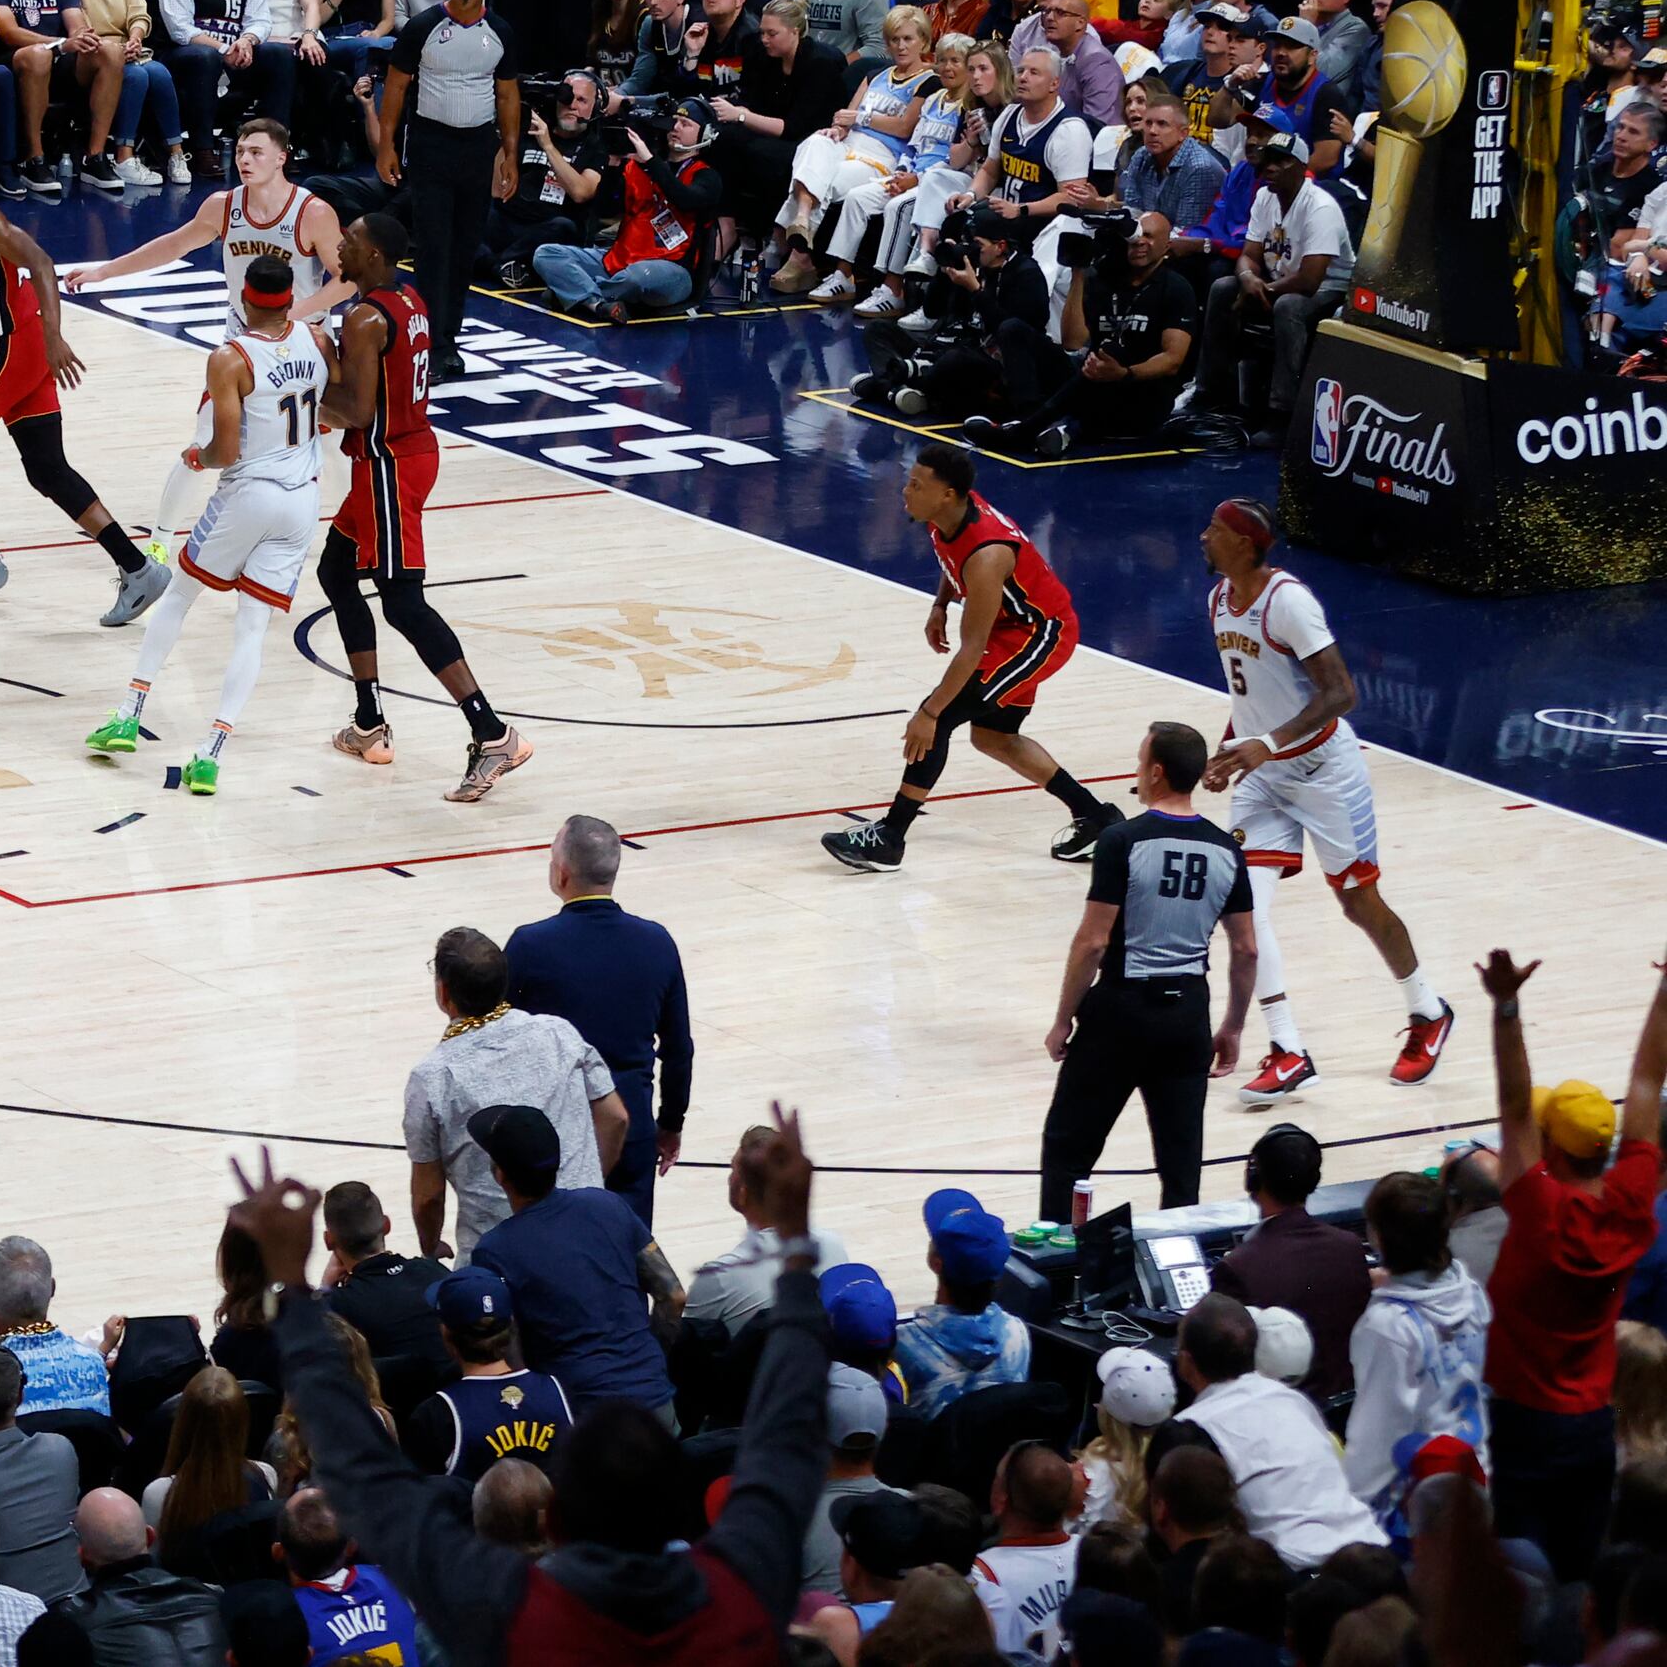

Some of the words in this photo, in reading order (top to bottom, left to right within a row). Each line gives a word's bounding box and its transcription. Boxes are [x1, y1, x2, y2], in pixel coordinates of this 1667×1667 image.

[1474, 115, 1506, 148] GET
[1001, 155, 1040, 185] ENVER
[1474, 150, 1503, 184] THE
[1471, 185, 1503, 219] APP
[280, 224, 295, 234] WU
[1375, 296, 1431, 332] YouTubeTV
[462, 317, 664, 390] ENVER
[267, 361, 316, 390] BROWN
[413, 349, 429, 405] 13
[278, 386, 319, 449] 11
[1323, 393, 1457, 486] Finals
[1229, 656, 1248, 695] 5
[1160, 850, 1208, 902] 58
[485, 1422, 556, 1460] JOKIĆ
[327, 1602, 388, 1646] JOKIĆ
